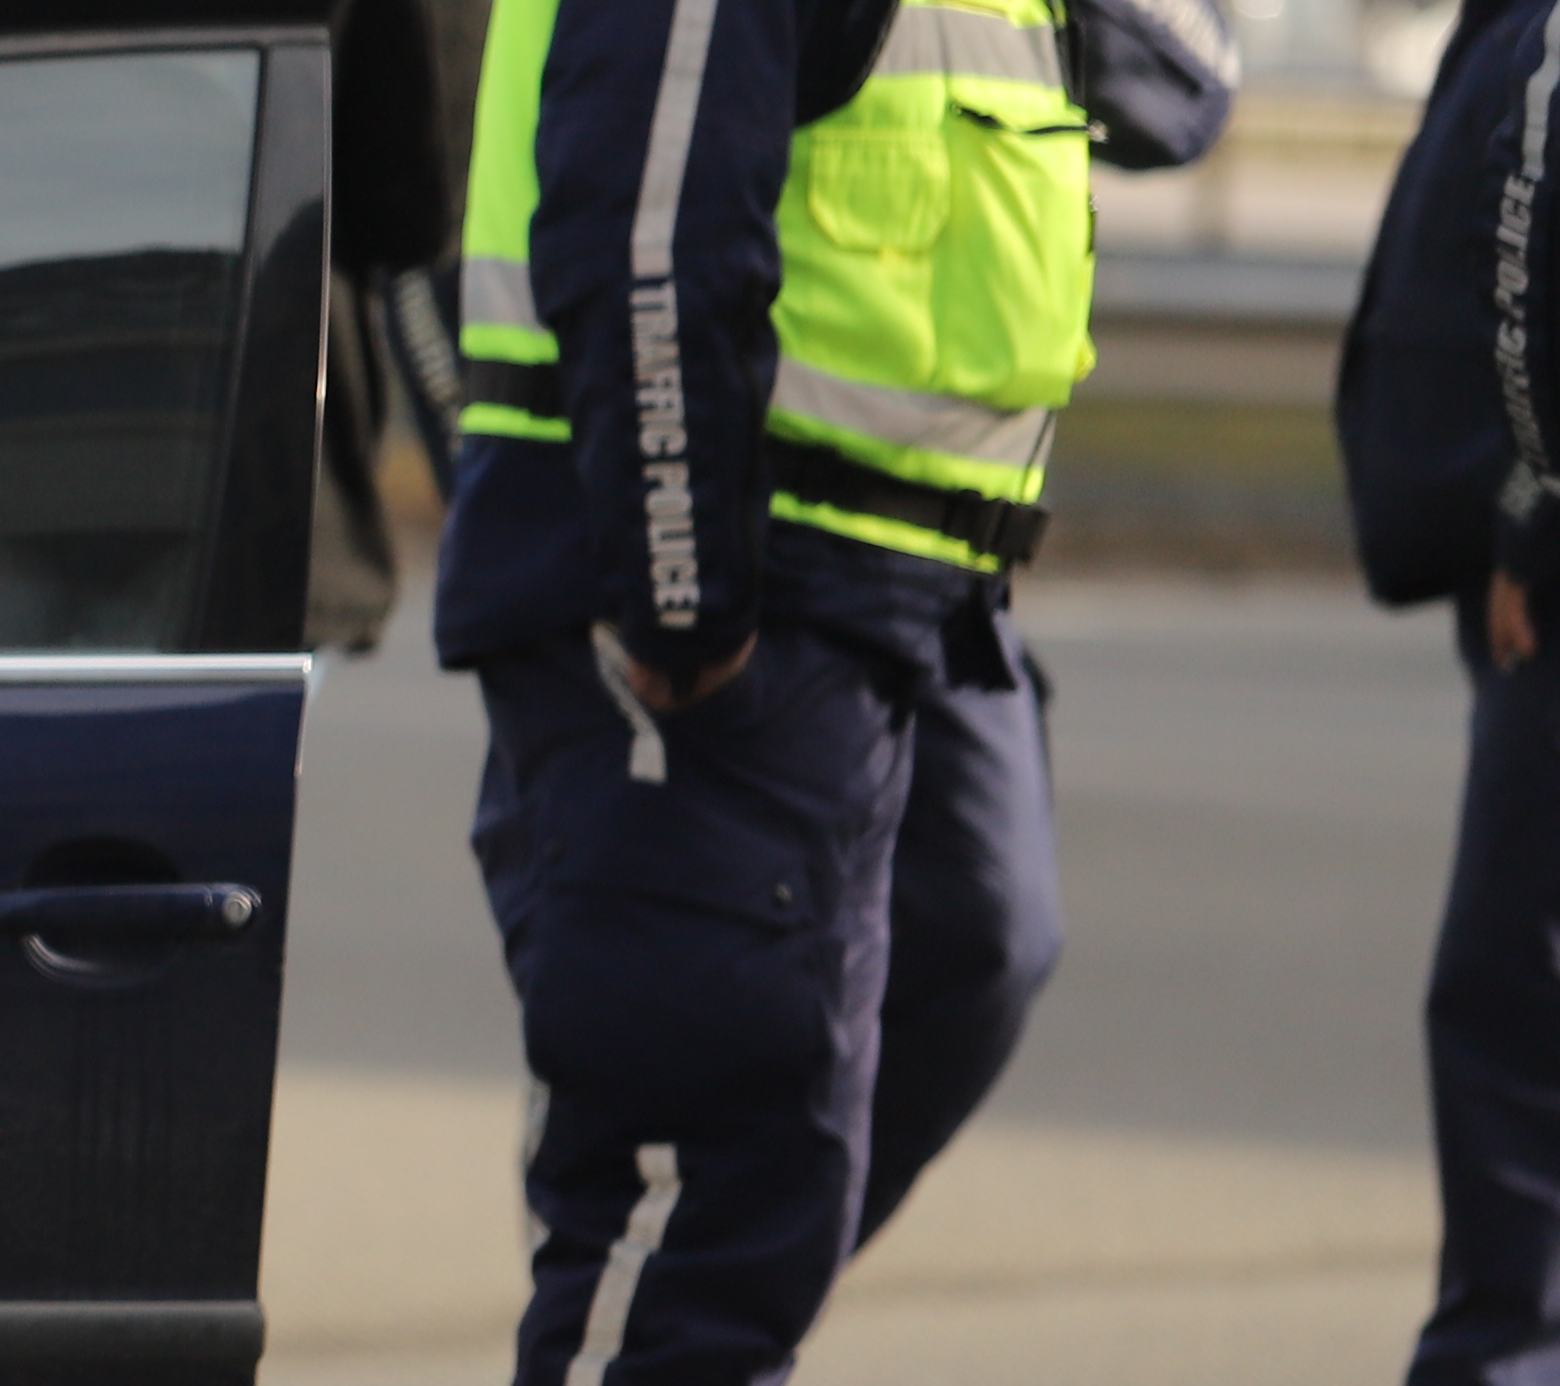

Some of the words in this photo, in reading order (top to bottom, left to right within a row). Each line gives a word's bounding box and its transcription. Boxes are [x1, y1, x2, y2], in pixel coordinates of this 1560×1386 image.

[1495, 174, 1537, 318] POLICE
[630, 282, 688, 456] TRAFFIC
[642, 462, 701, 609] POLICE
